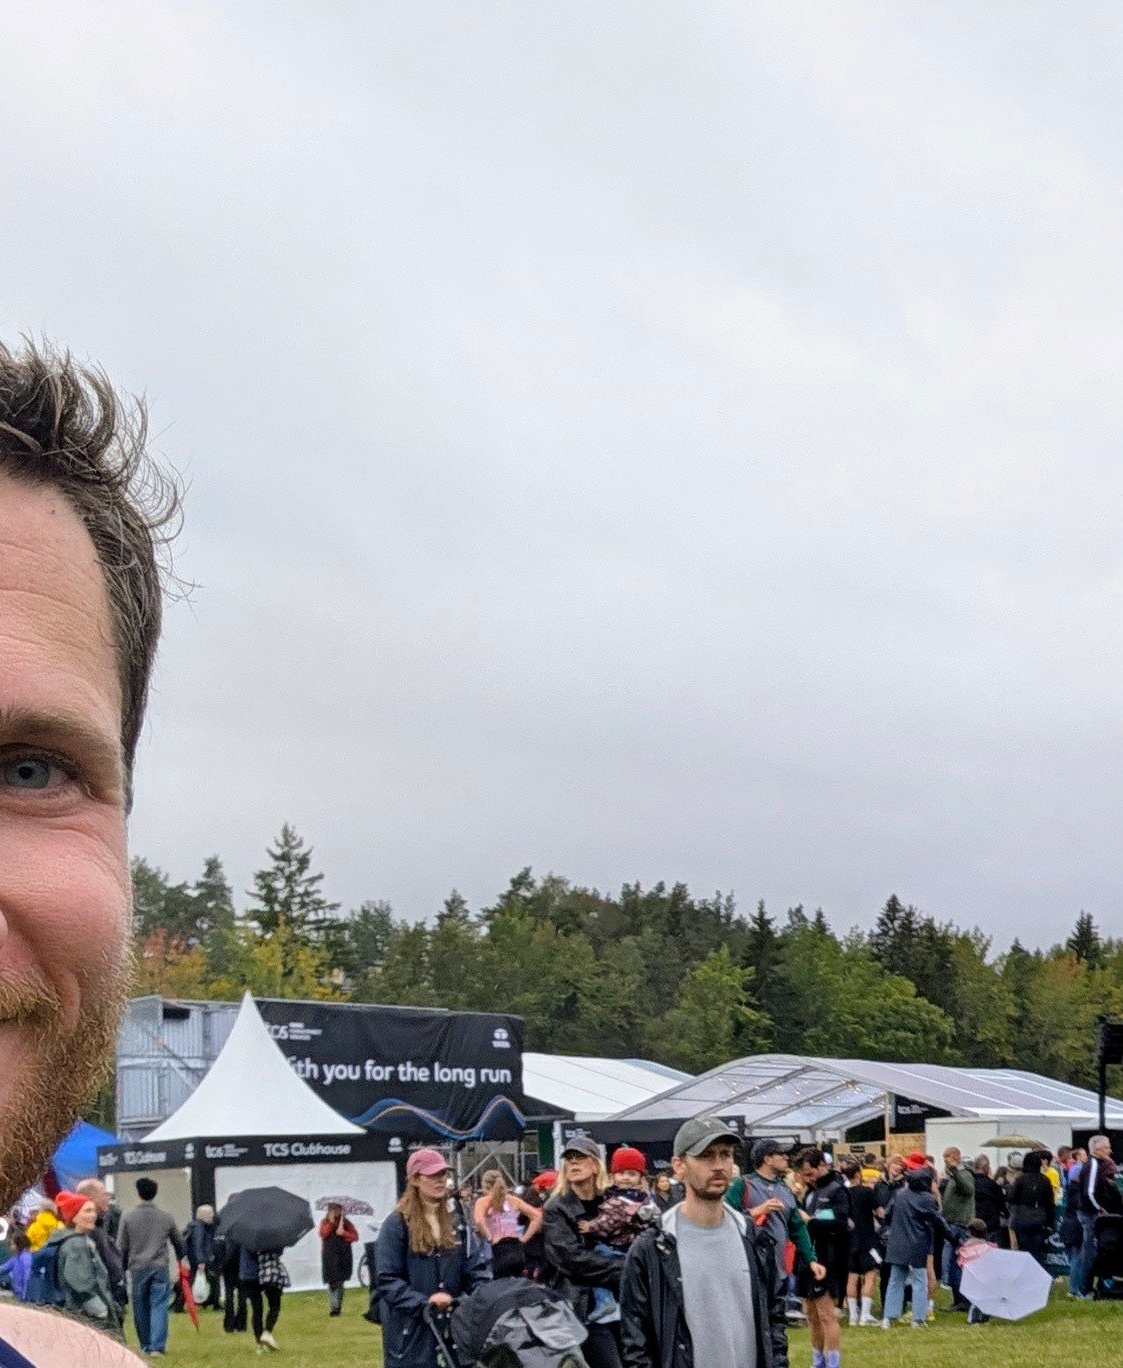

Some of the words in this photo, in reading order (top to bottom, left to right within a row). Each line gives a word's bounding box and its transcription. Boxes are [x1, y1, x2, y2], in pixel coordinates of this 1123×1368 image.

[289, 1057, 319, 1079] ith
[322, 1062, 361, 1085] you
[364, 1058, 395, 1081] for
[397, 1061, 431, 1082] the
[434, 1061, 476, 1088] long
[480, 1066, 512, 1084] run
[263, 1143, 289, 1157] TCS
[291, 1142, 351, 1156] Clubhouse
